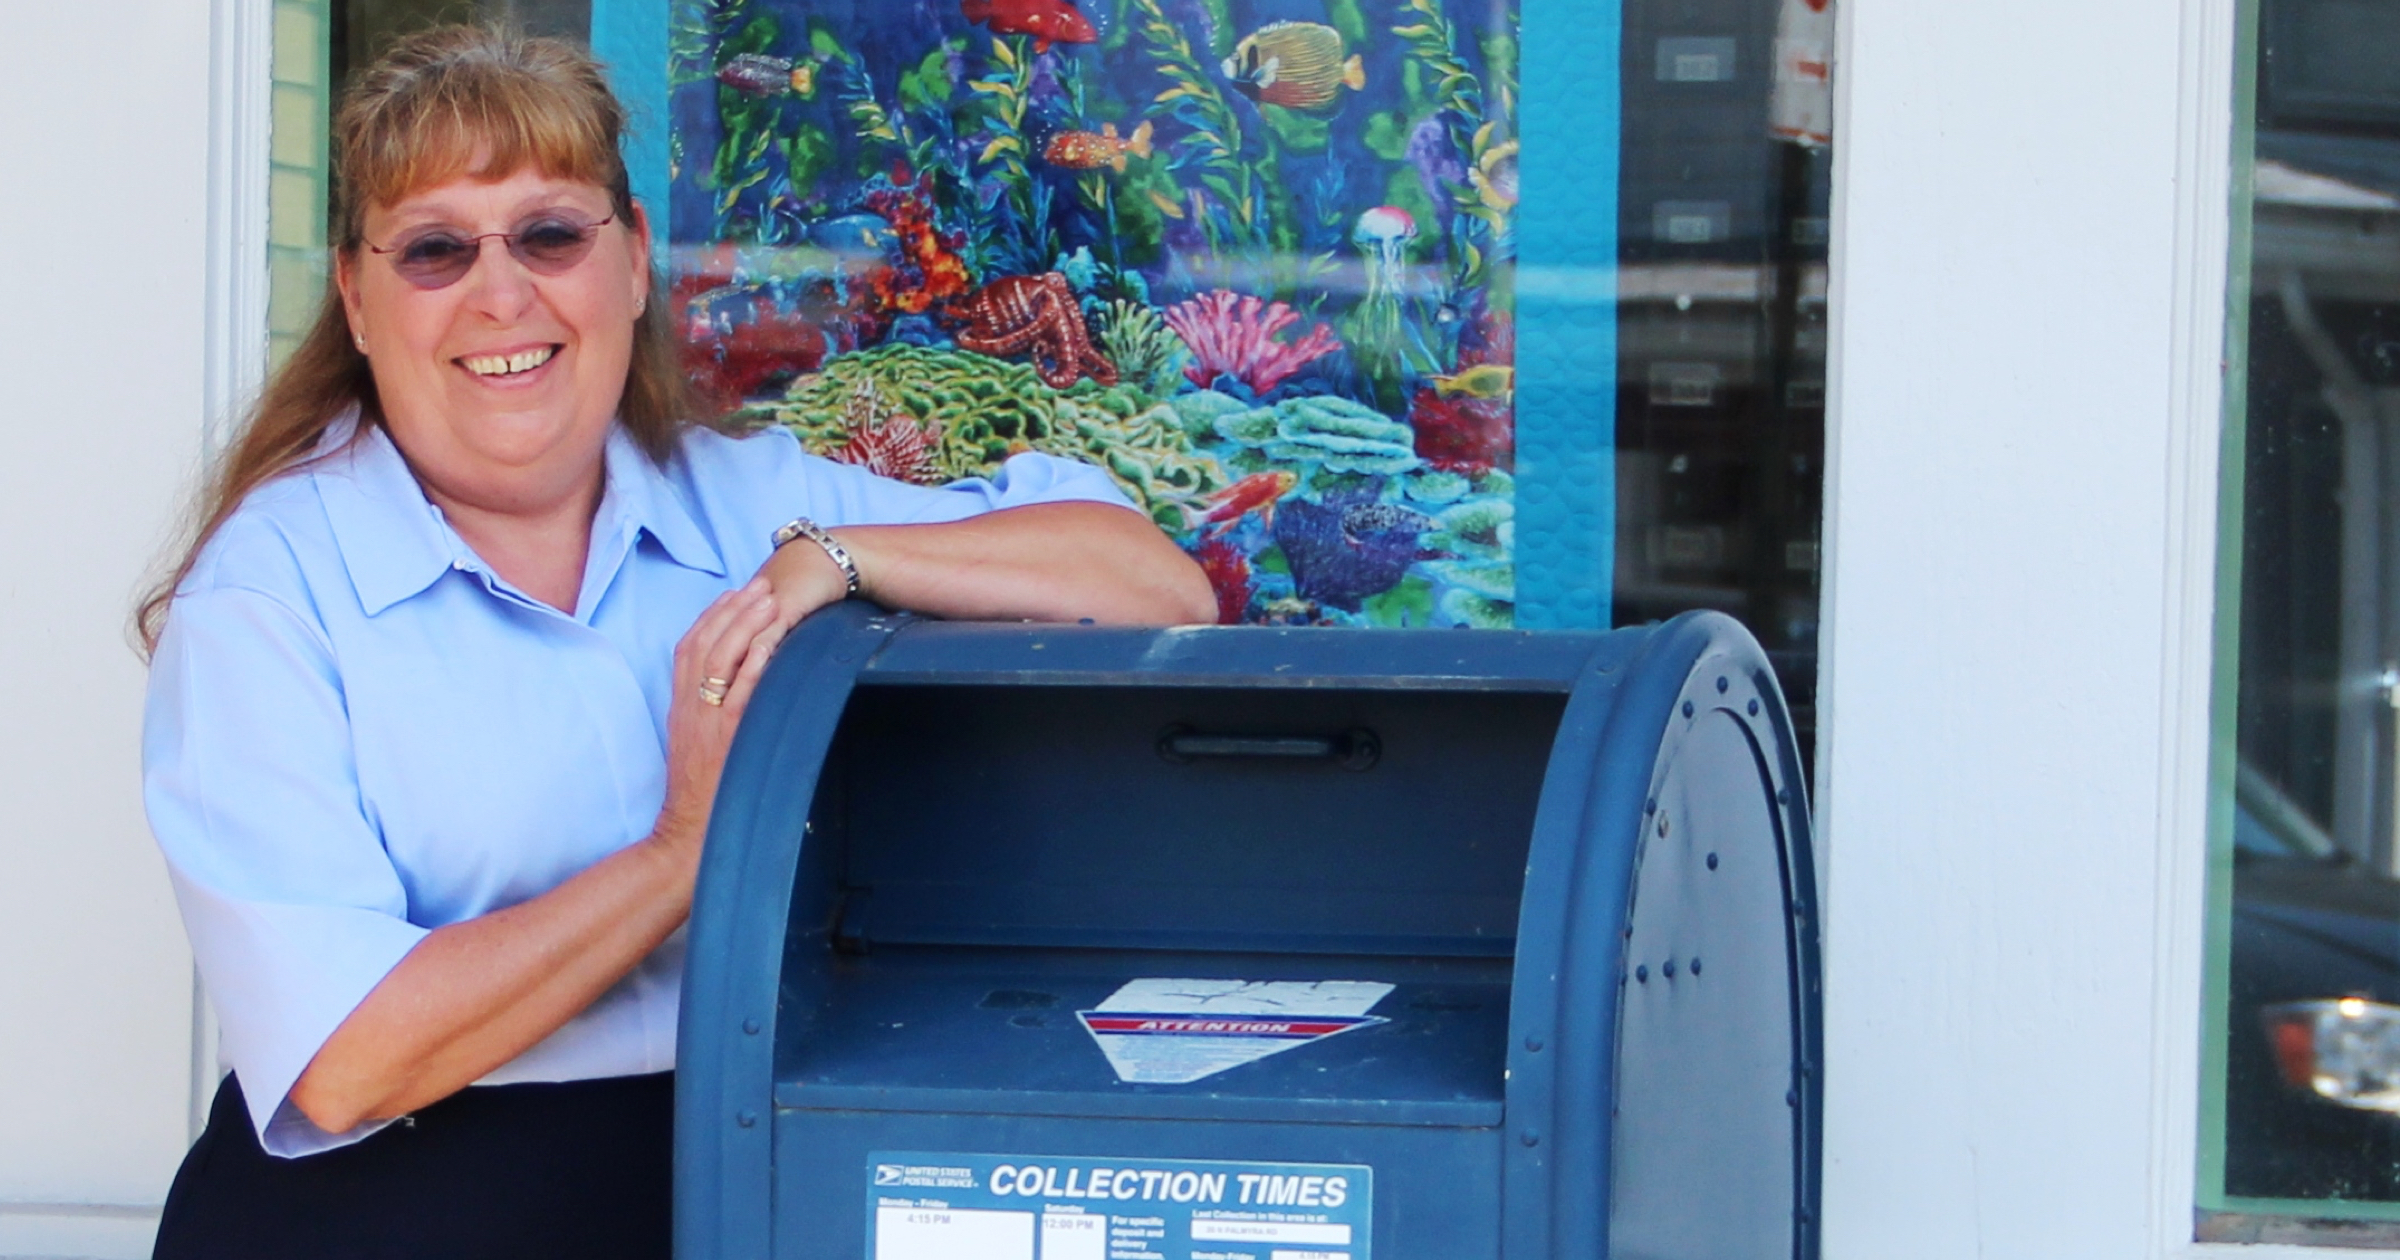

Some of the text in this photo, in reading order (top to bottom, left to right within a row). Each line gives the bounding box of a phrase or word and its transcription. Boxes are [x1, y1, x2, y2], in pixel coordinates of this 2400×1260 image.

[1138, 1021, 1291, 1033] ATTENTION
[989, 1164, 1348, 1208] COLLECTION TIMES
[933, 1214, 951, 1224] PM
[1076, 1219, 1094, 1229] PM
